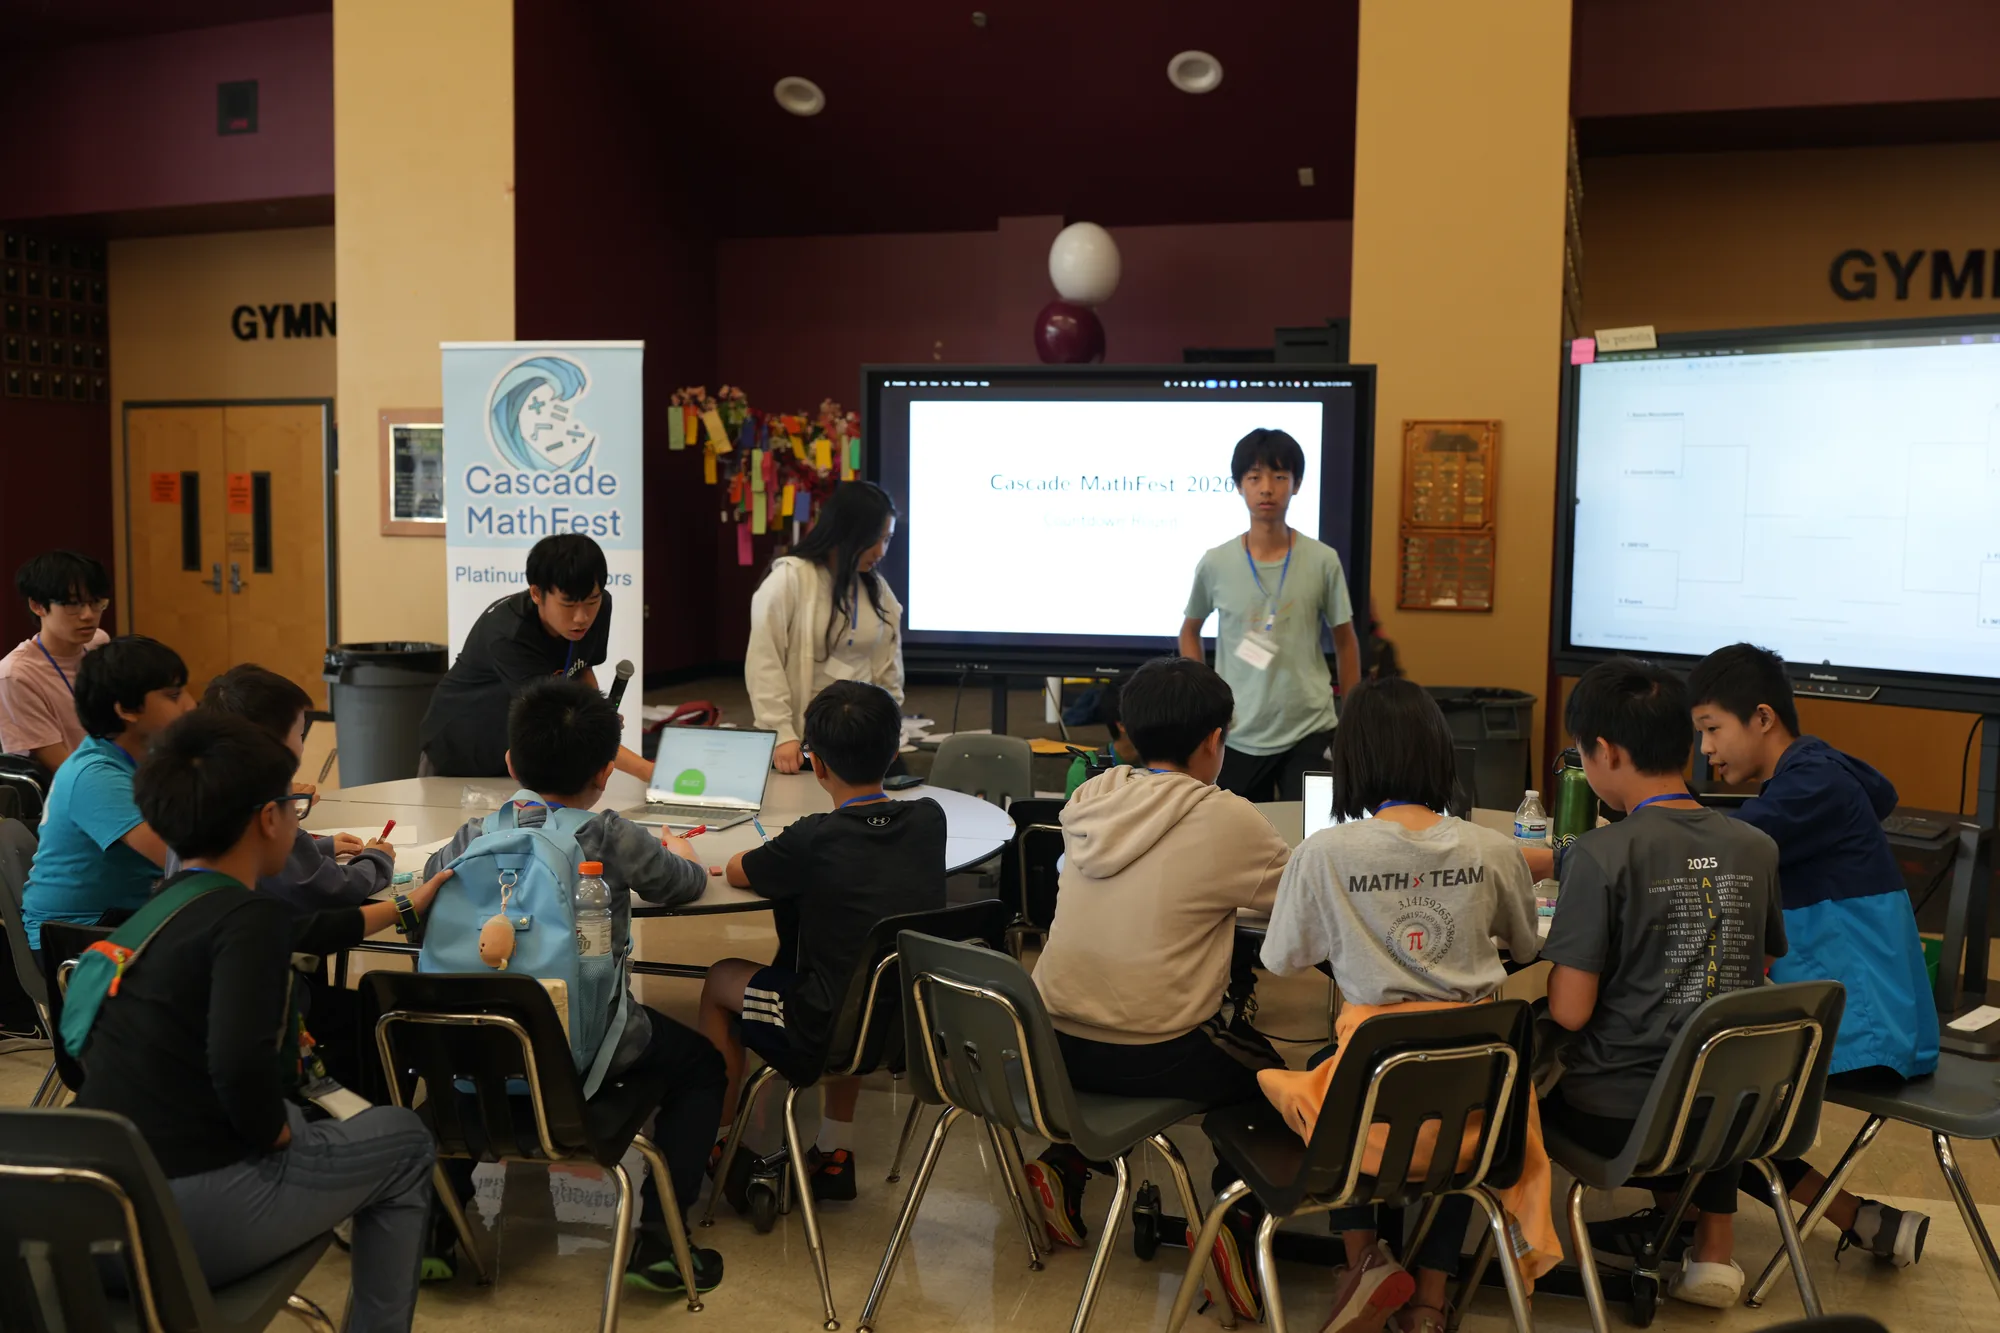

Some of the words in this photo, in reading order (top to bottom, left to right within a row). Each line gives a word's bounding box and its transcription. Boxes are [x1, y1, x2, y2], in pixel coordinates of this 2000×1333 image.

[466, 465, 617, 496] Cascade
[990, 474, 1072, 491] Cascade
[1081, 475, 1175, 492] MathFest
[1187, 476, 1236, 493] 2026
[468, 505, 621, 537] MathFest
[1687, 857, 1718, 870] 2025
[1349, 873, 1409, 893] MATH
[1429, 866, 1484, 888] TEAM
